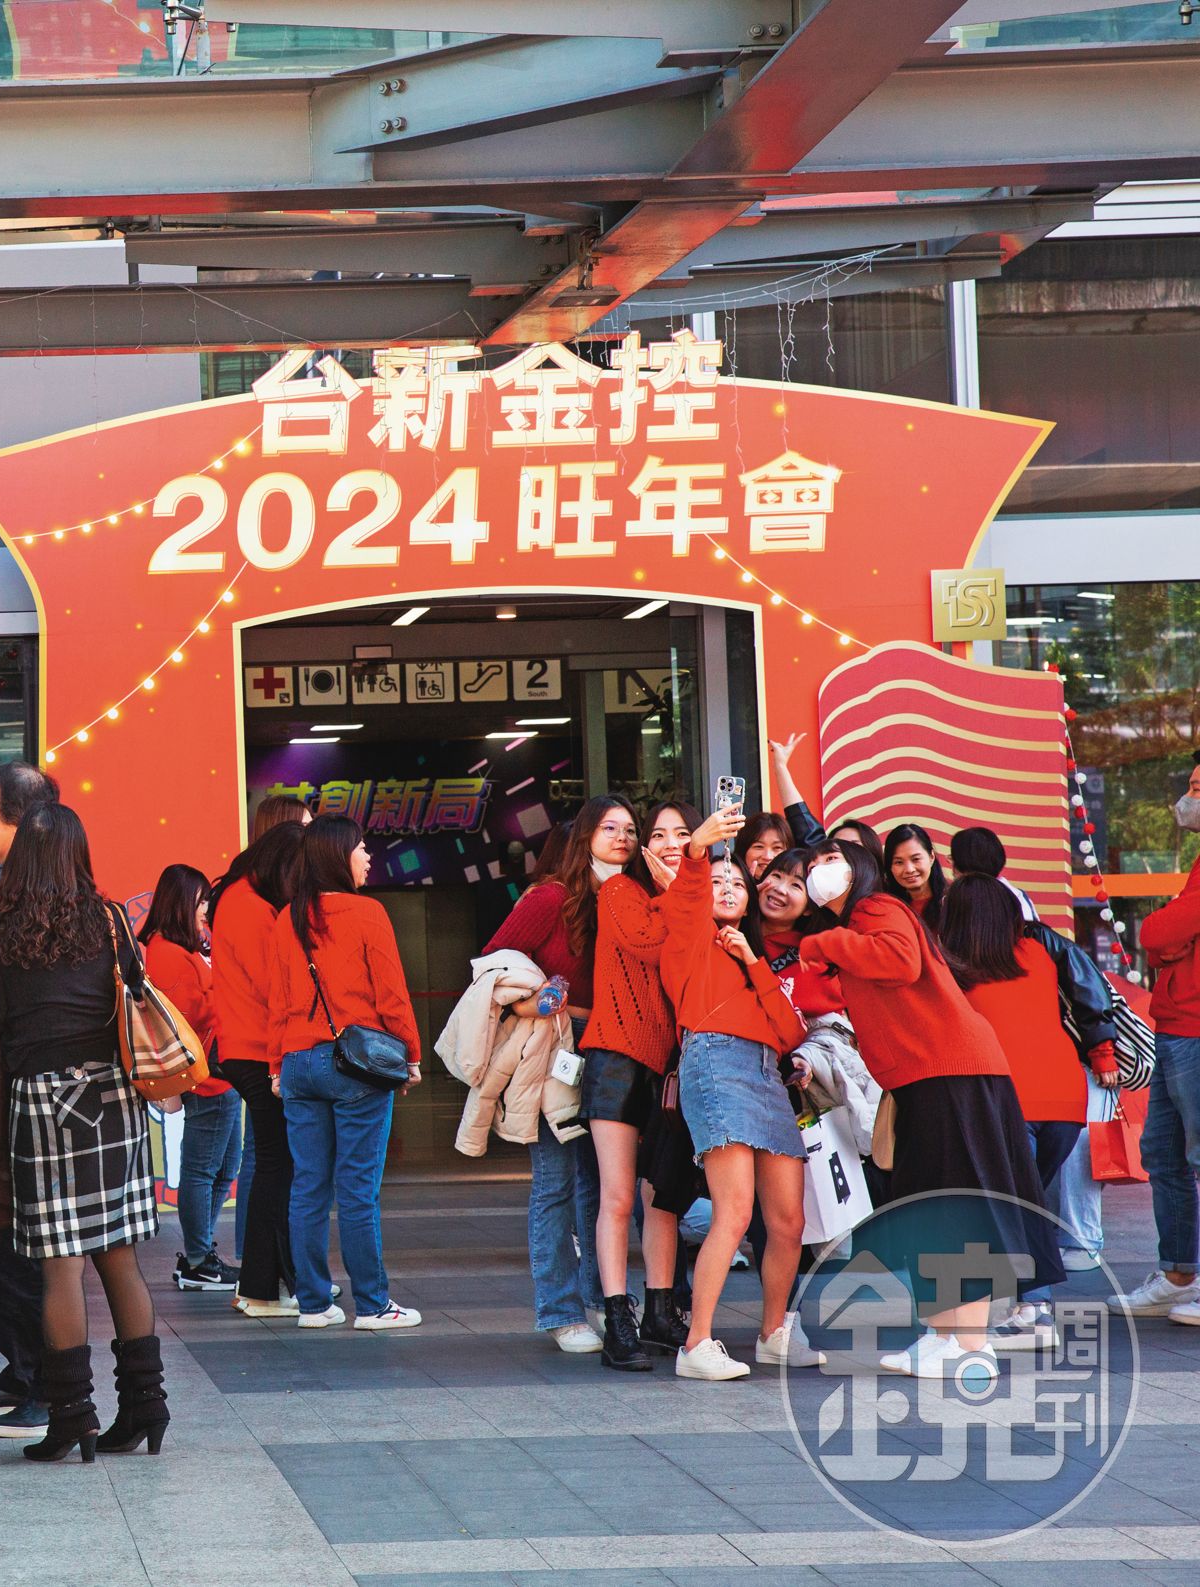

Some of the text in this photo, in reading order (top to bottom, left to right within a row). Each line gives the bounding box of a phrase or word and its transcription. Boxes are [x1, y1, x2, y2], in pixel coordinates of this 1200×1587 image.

[252, 328, 724, 456] 台新金控
[526, 659, 549, 689] 2
